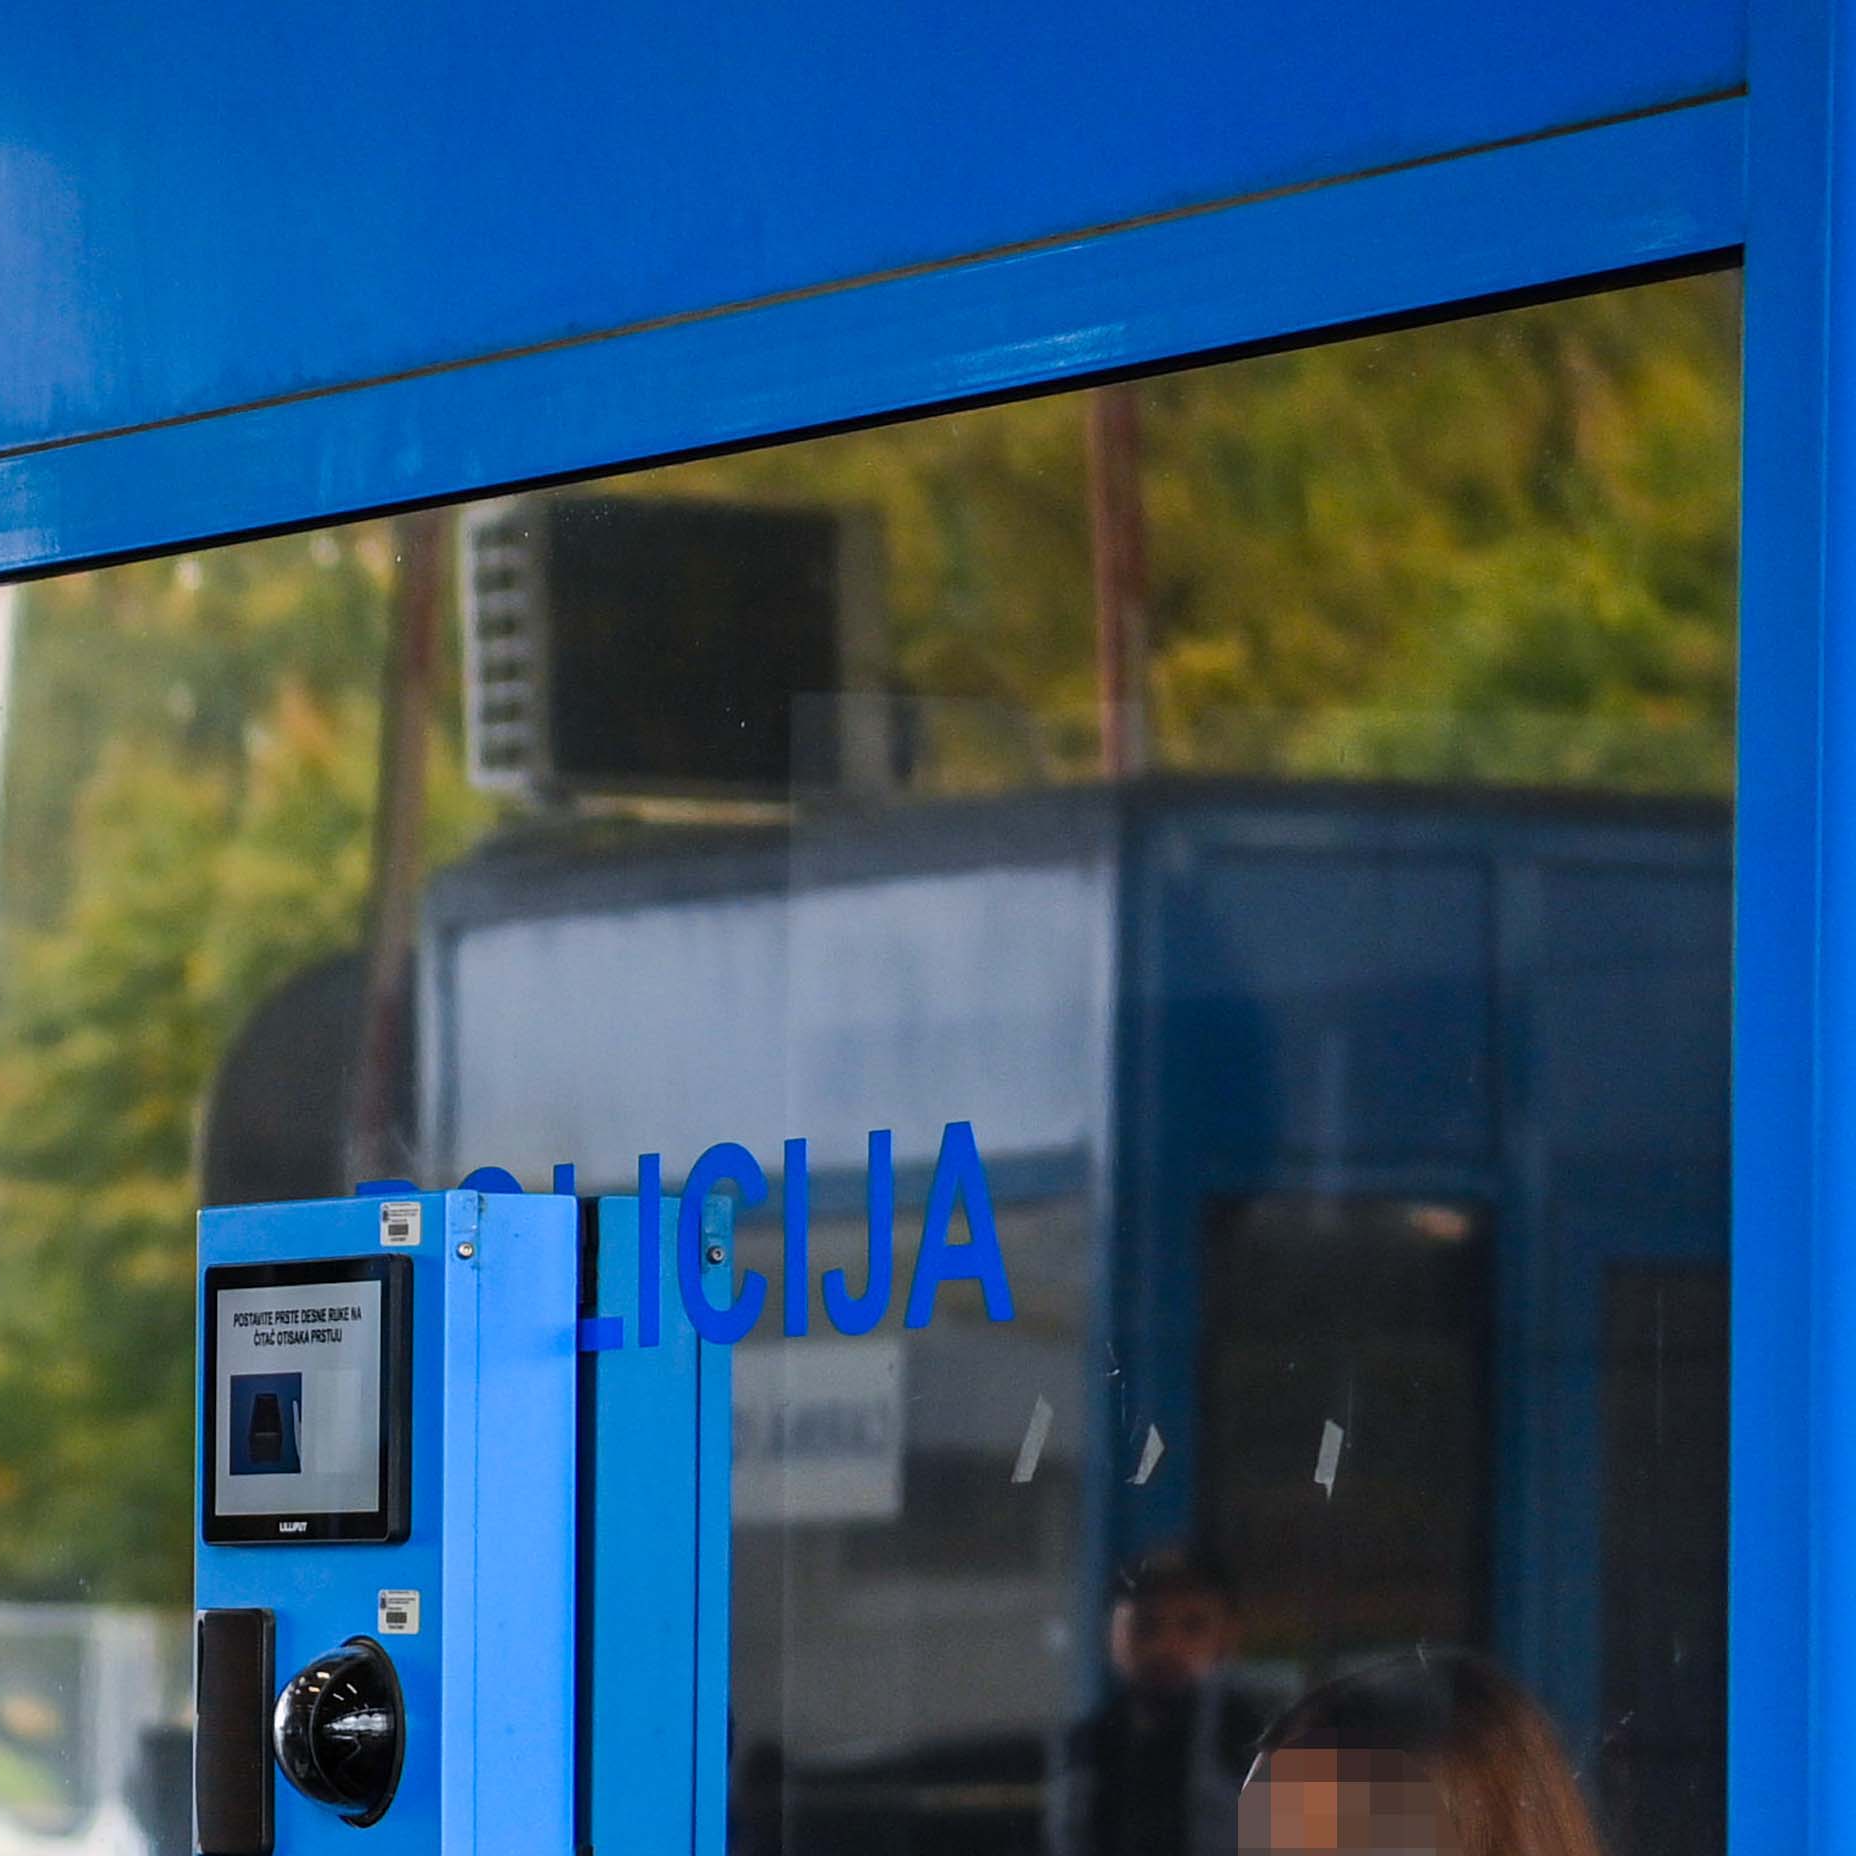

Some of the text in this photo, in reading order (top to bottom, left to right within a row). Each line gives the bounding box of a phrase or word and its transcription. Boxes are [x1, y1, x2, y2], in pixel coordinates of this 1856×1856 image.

[356, 1121, 1015, 1351] ICIJA
[233, 1305, 362, 1328] POSTAVITE PRSTE DESNE RUKE NA
[276, 1330, 309, 1346] OTISAKA
